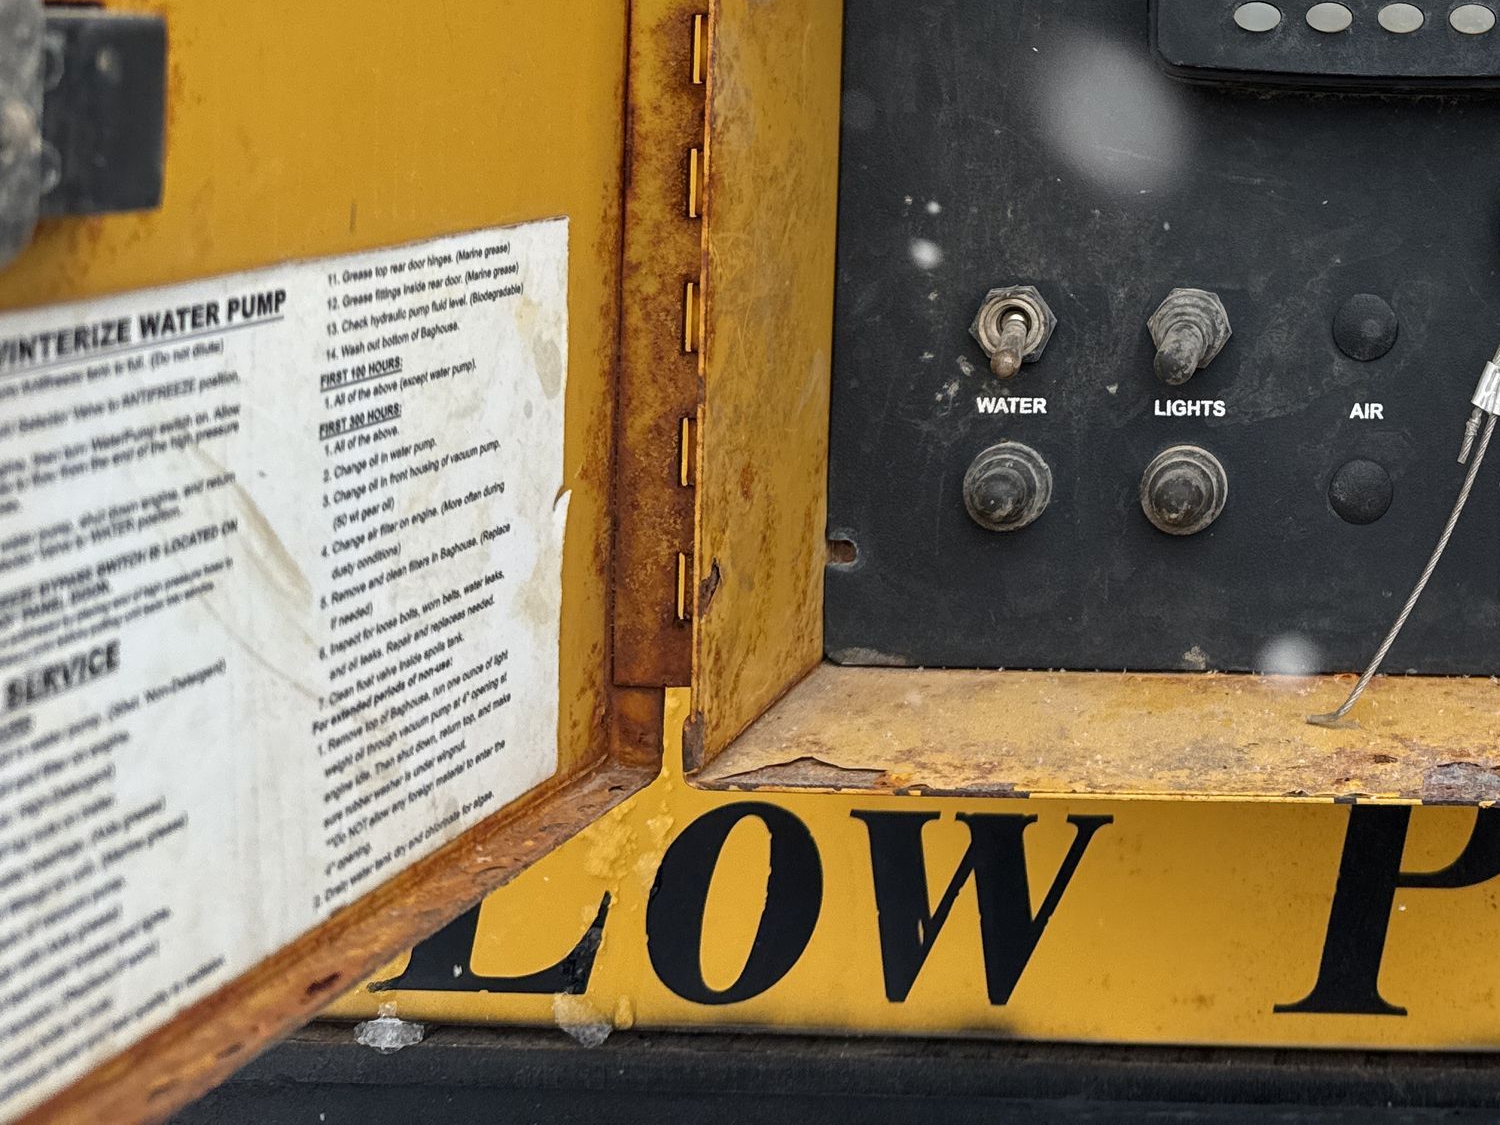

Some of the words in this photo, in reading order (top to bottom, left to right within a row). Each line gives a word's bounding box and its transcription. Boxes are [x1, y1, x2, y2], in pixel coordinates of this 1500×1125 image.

[341, 268, 372, 283] Grease
[389, 262, 405, 273] rear
[407, 258, 425, 271] door
[426, 253, 453, 268] hinges.
[455, 247, 482, 264] (Marine
[483, 241, 510, 259] grease)
[342, 292, 372, 308] Grease
[374, 286, 401, 300] fittings
[402, 280, 426, 295] inside
[427, 278, 443, 290] rear
[444, 274, 462, 287] door.
[464, 268, 491, 285] (Marine
[492, 261, 519, 279] grease)
[139, 301, 219, 338] WATER
[226, 289, 286, 322] PUMP
[341, 315, 368, 333] Check
[370, 308, 406, 328] hydraulic
[408, 304, 429, 320] pump
[431, 298, 447, 312] fluid
[448, 293, 467, 308] level.
[469, 282, 523, 306] (Biodegradable)
[340, 341, 365, 357] Wash
[366, 337, 380, 352] out
[381, 332, 409, 348] bottom
[420, 321, 459, 339] Baghouse.
[319, 368, 348, 389] FIRST
[350, 364, 366, 381] 100
[368, 355, 402, 376] HOURS:
[357, 387, 371, 401] the
[372, 380, 397, 396] above
[399, 371, 428, 391] (except
[429, 366, 450, 380] water
[451, 357, 476, 378] pump).
[318, 416, 346, 438] FIRST
[349, 412, 365, 429] 300
[366, 402, 401, 424] HOURS:
[976, 396, 1047, 414] WATER
[1154, 399, 1226, 417] LIGHTS
[1349, 402, 1384, 420] AIR
[357, 433, 371, 446] the
[372, 425, 398, 442] above.
[333, 459, 367, 479] Change
[389, 444, 412, 460] water
[413, 437, 436, 456] pump.
[333, 483, 366, 504] Change
[389, 468, 408, 484] front
[409, 459, 439, 477] housing
[449, 446, 478, 463] vacuum
[479, 439, 500, 456] pump.
[331, 533, 365, 554] Change
[379, 521, 398, 536] filter
[440, 497, 462, 515] (More
[463, 490, 481, 504] often
[482, 481, 504, 497] during
[332, 512, 347, 531] (50
[360, 503, 380, 522] gear
[330, 582, 366, 604] Remove
[367, 572, 384, 589] and
[385, 565, 407, 582] clean
[408, 556, 429, 572] filters
[479, 523, 510, 545] (Replace
[331, 562, 354, 580] dusty
